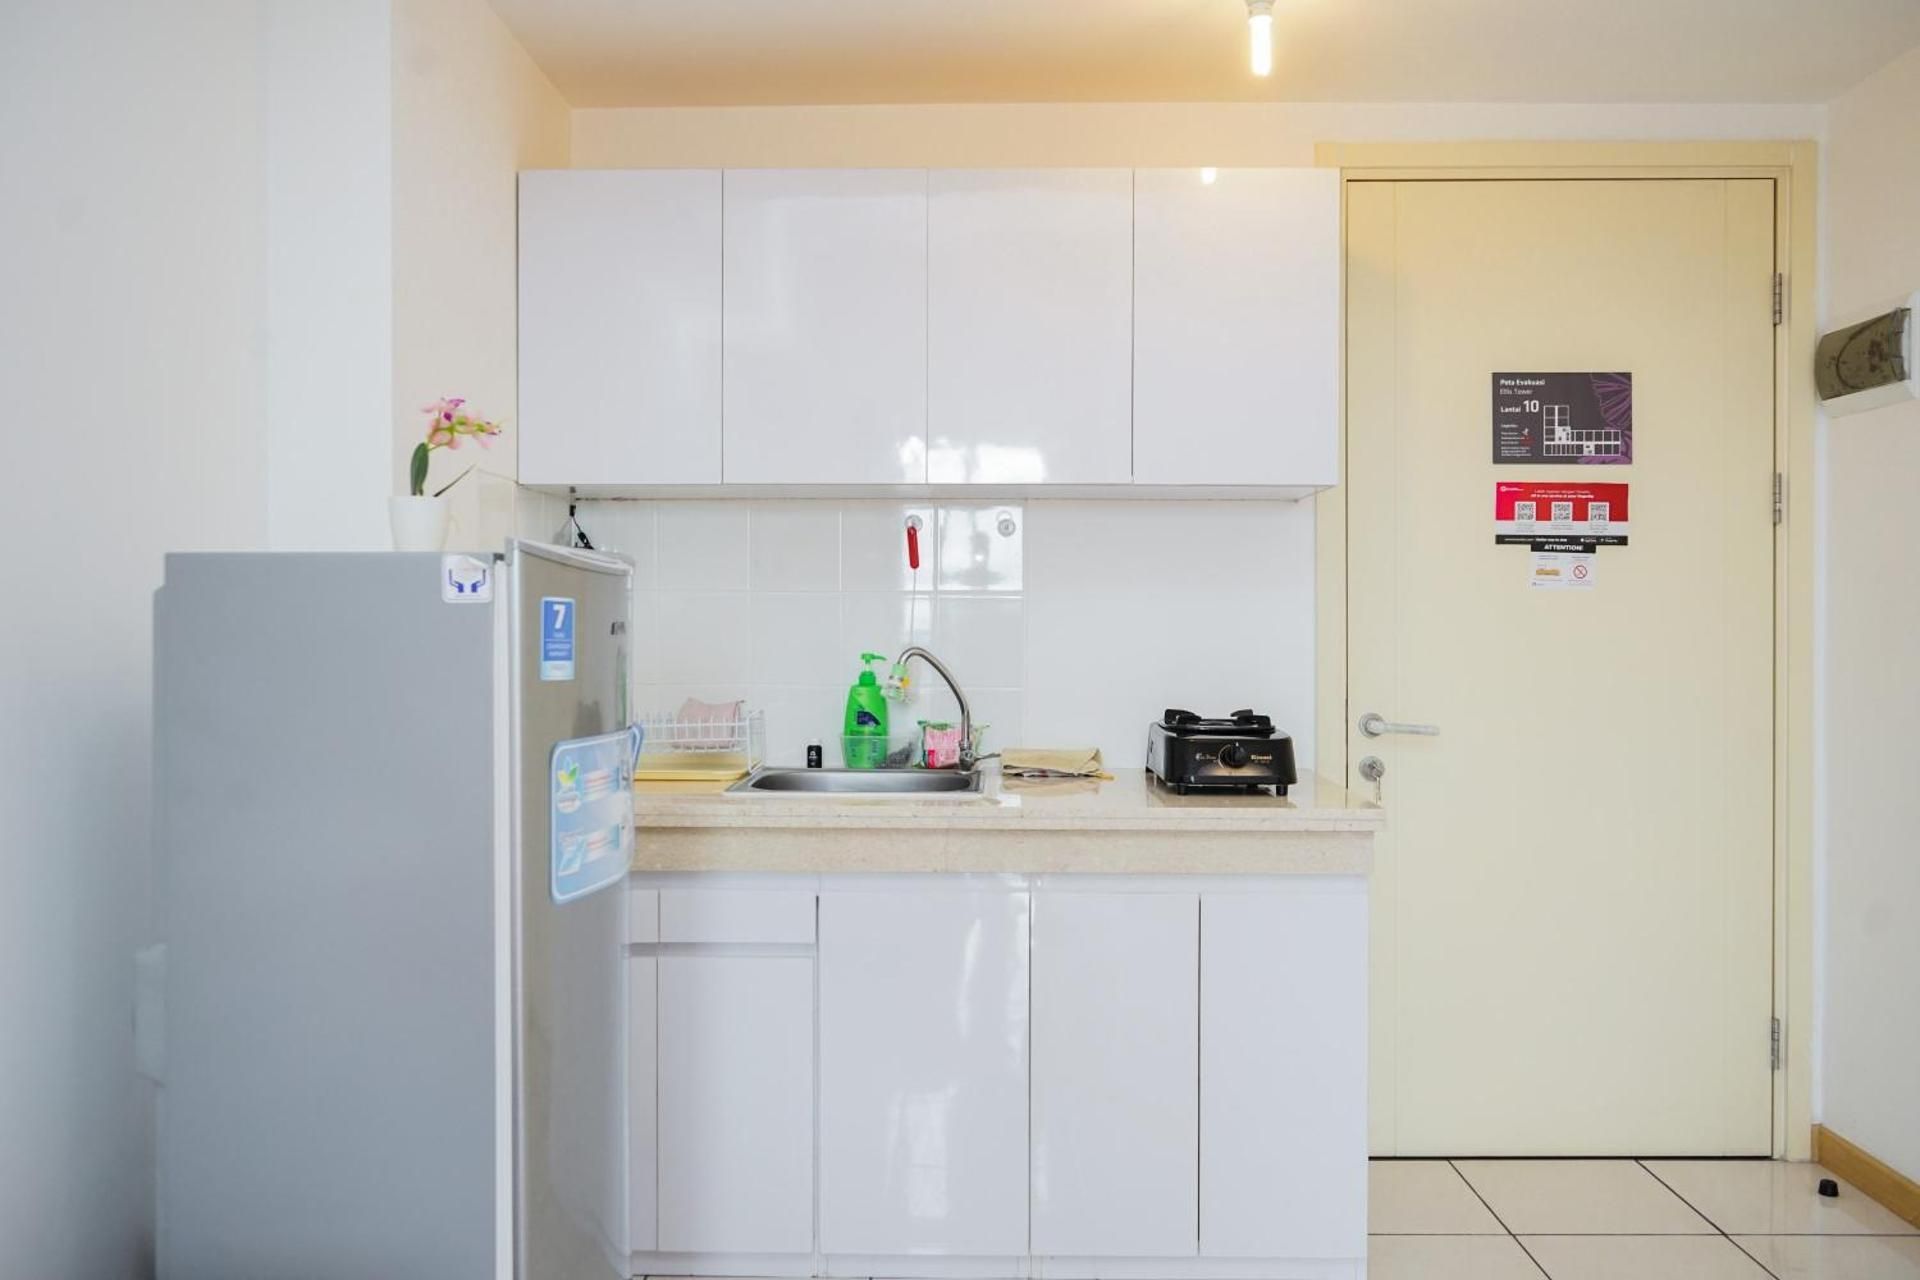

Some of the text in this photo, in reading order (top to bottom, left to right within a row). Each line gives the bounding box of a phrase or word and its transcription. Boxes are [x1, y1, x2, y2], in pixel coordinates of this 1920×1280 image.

[1500, 400, 1539, 413] Lantai 10
[552, 603, 566, 630] 7
